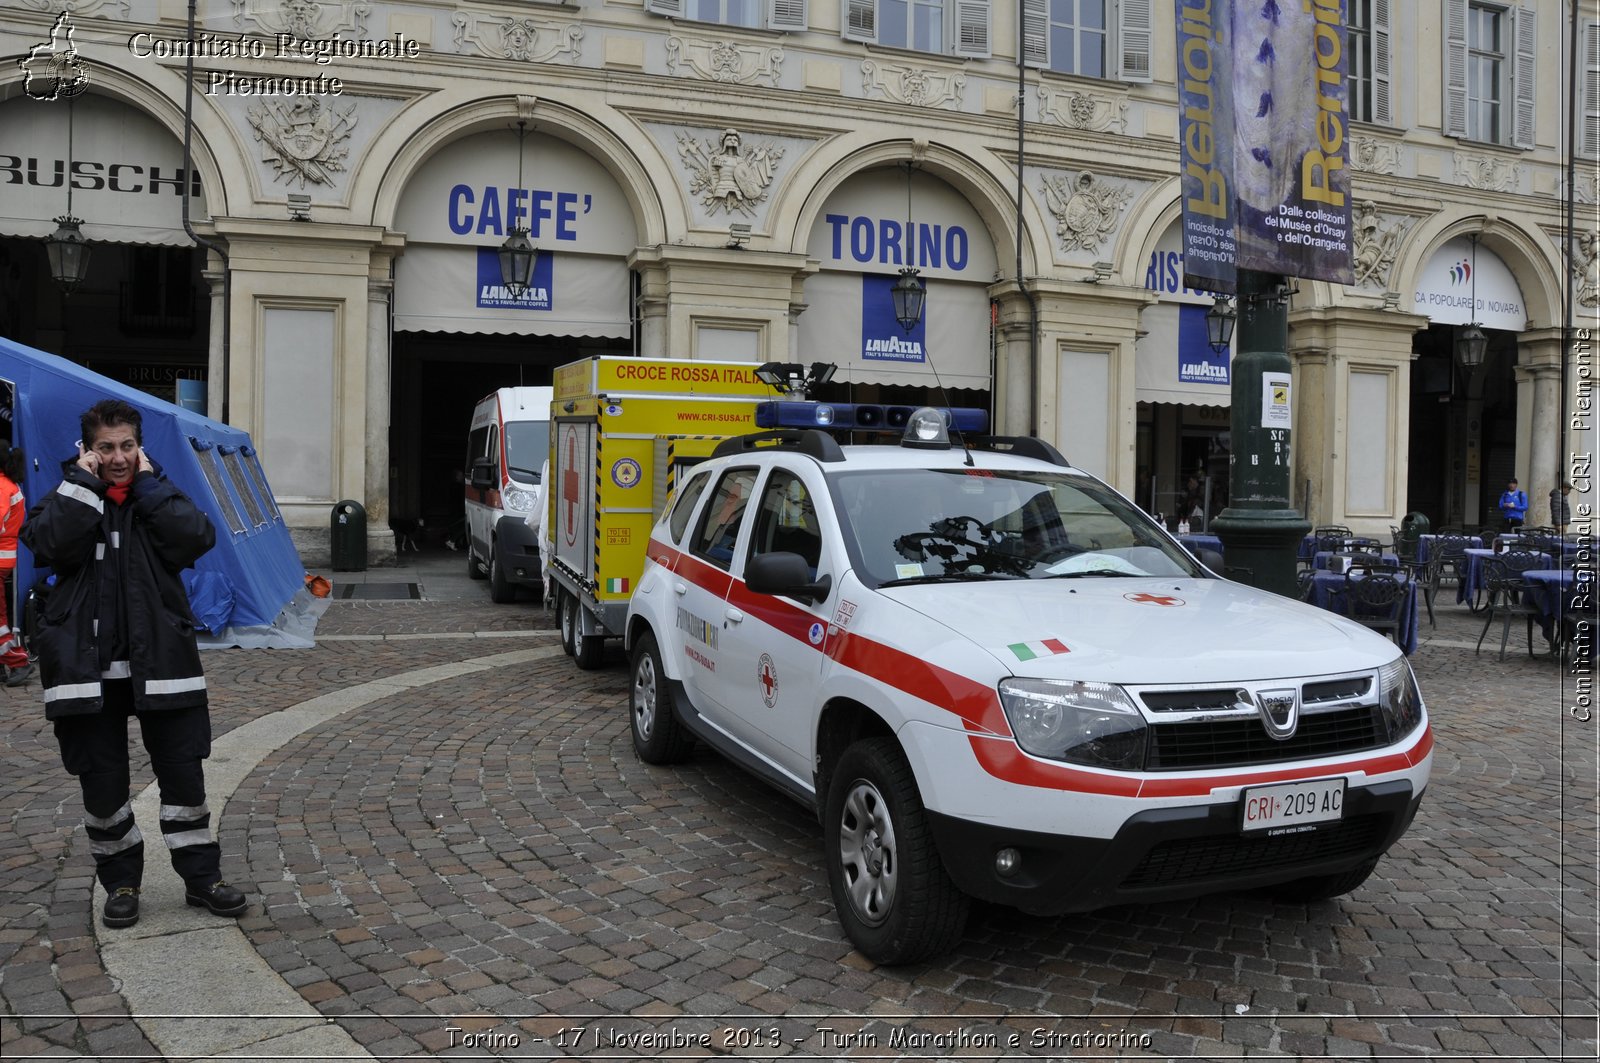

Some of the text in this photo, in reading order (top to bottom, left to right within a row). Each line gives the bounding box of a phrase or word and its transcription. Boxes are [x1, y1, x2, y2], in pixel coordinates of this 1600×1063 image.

[1280, 204, 1346, 225] Dalle collezioni
[1265, 215, 1346, 240] del Musée d'Orsay
[826, 213, 969, 271] TORINO
[1276, 231, 1347, 251] e dell'Orangerie
[1429, 293, 1474, 309] POPOLARE
[1476, 299, 1485, 311] DI
[1488, 301, 1520, 316] NOVARA
[866, 336, 922, 355] LAVAZZA
[616, 364, 668, 381] CROCE
[671, 366, 720, 383] ROSSA
[1181, 360, 1228, 378] LAVAZZA
[677, 411, 751, 423] WWW.CRI-SUSA.IT
[1270, 429, 1285, 441] SC
[1251, 454, 1259, 466] B
[1265, 696, 1295, 705] DACIA
[1247, 788, 1342, 821] CRI 209 AC
